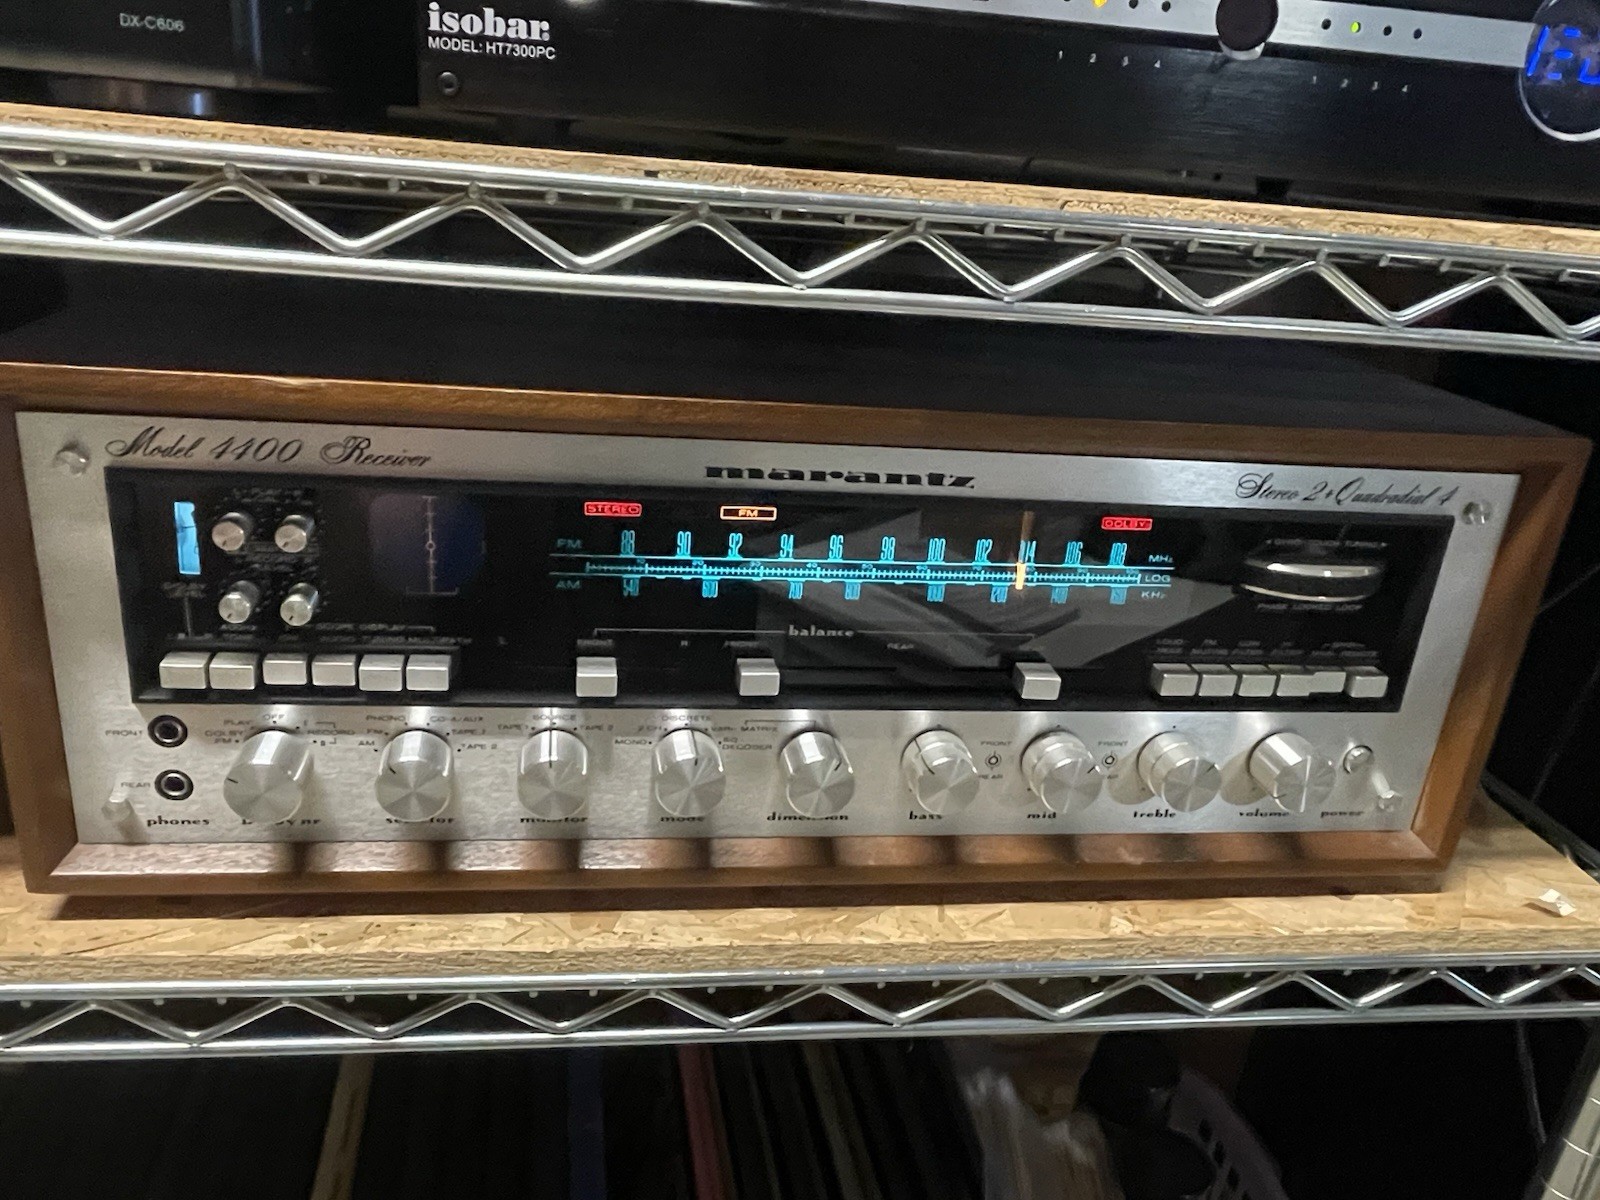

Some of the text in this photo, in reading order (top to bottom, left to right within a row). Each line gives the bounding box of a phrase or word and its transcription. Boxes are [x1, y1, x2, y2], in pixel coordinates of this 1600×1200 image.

[427, 36, 556, 60] MODEL: HT7300PC
[1089, 53, 1097, 63] 2
[105, 425, 206, 459] Model
[320, 435, 431, 467] Receiver
[705, 466, 975, 489] marantz
[1235, 472, 1299, 500] Stereo
[1336, 477, 1443, 506] Quadradial
[587, 504, 639, 514] STEREO
[738, 508, 758, 518] FM
[621, 530, 635, 554] 88
[677, 531, 692, 555] 90
[728, 533, 743, 557] 92
[780, 534, 794, 558] 94
[829, 535, 844, 559] 96
[881, 536, 896, 560] 98
[928, 538, 946, 562] 100
[975, 539, 993, 563] 102
[1065, 541, 1083, 565] 106
[556, 580, 581, 589] AM
[1145, 575, 1171, 583] LOG
[788, 625, 855, 637] balance
[1133, 810, 1176, 818] treble
[1239, 809, 1290, 817] volume
[146, 815, 210, 827] phones
